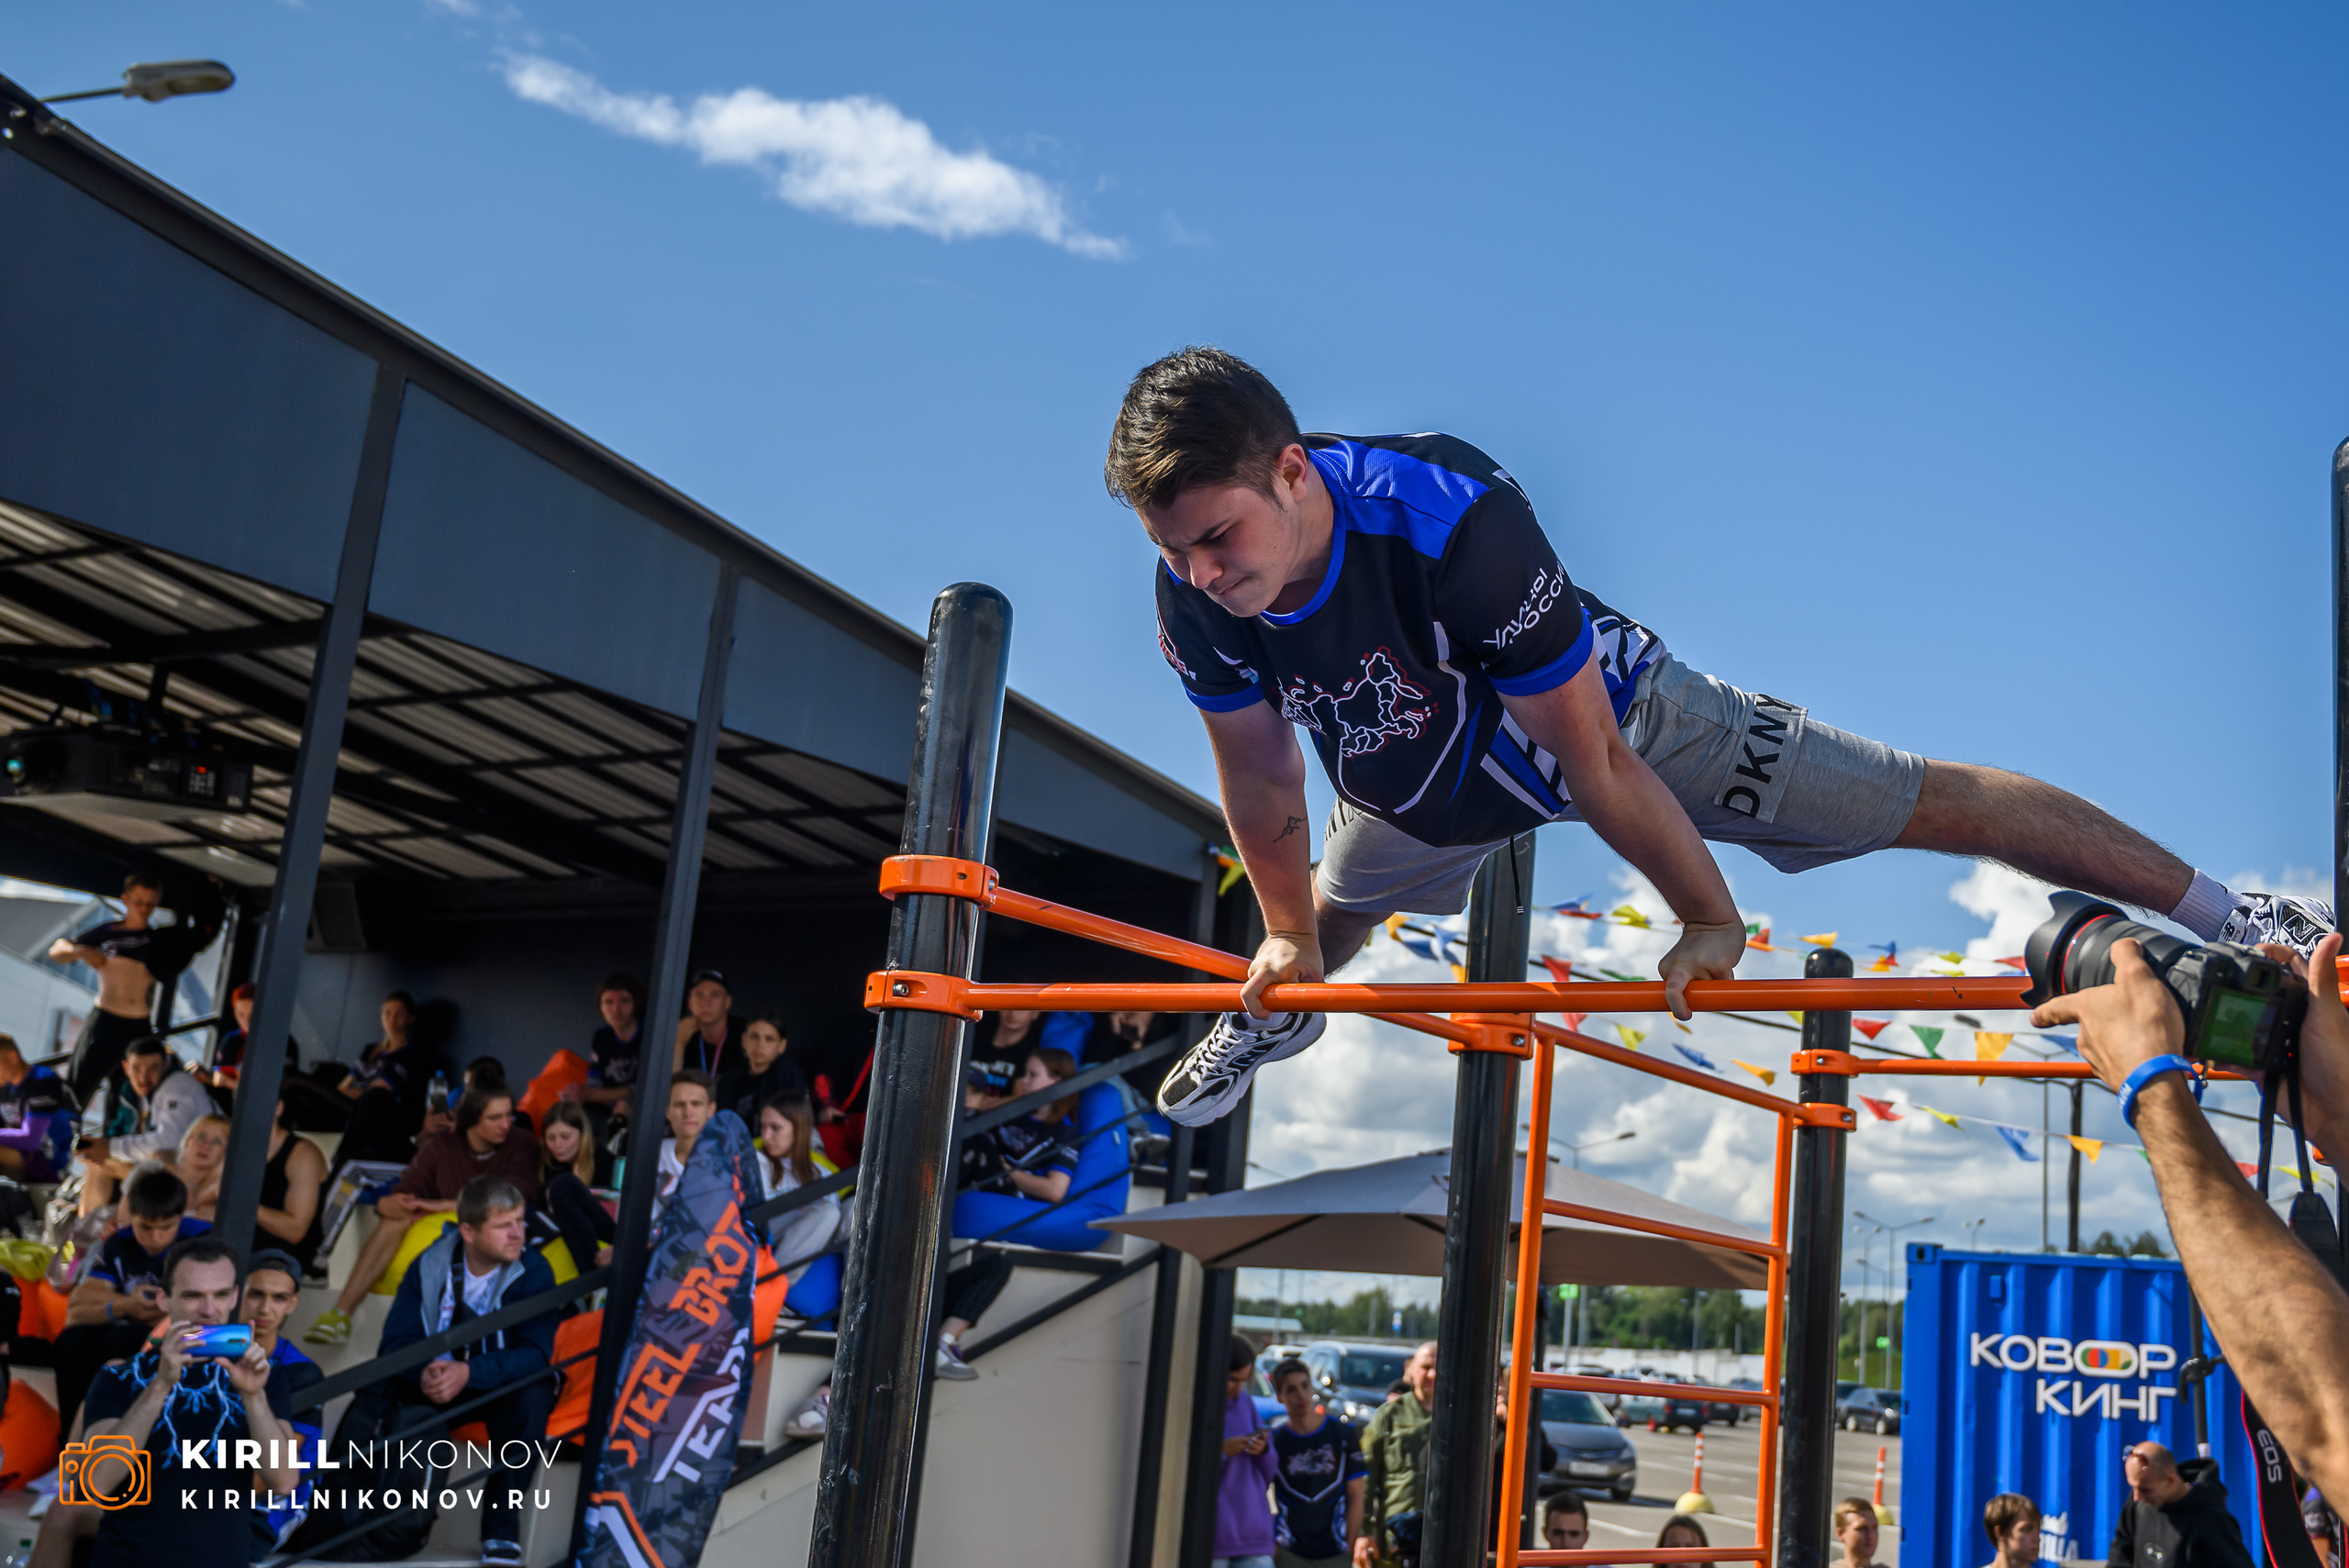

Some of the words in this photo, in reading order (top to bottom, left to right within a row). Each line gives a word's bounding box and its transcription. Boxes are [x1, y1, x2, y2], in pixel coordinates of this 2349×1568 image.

[1721, 693, 1792, 818] DKNY
[668, 1195, 753, 1328] BROT
[1970, 1331, 2178, 1380] КОВОР
[2036, 1377, 2178, 1423] КИНГ
[2256, 1428, 2283, 1484] EOS
